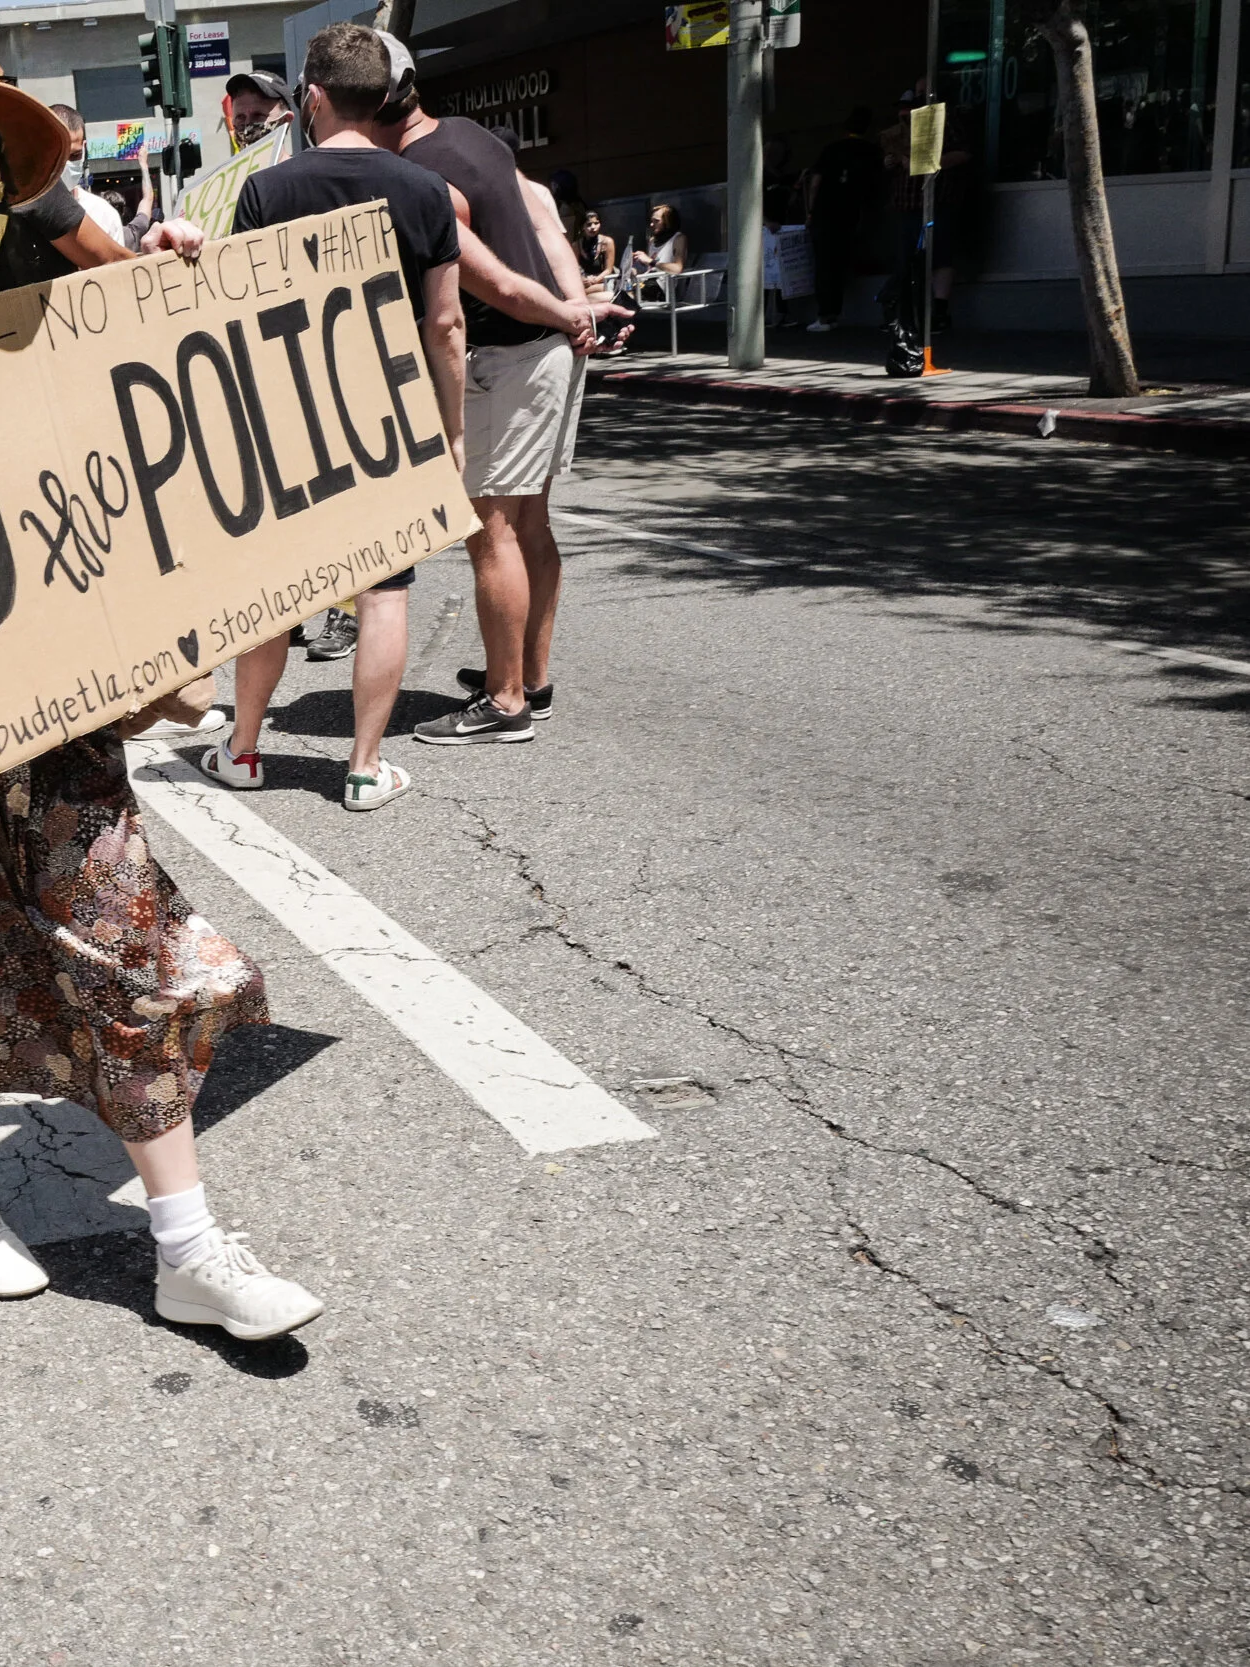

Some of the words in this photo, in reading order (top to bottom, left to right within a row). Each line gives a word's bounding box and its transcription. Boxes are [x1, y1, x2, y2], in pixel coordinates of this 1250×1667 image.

[190, 32, 202, 40] For
[203, 31, 225, 39] Lease
[438, 92, 462, 116] EST
[465, 69, 550, 112] HOLLYWOOD
[959, 55, 1019, 105] 830
[39, 279, 108, 351] NO
[132, 227, 294, 324] PEACE!
[322, 205, 395, 273] #AFTP
[20, 450, 129, 594] the
[110, 270, 445, 577] POLICE
